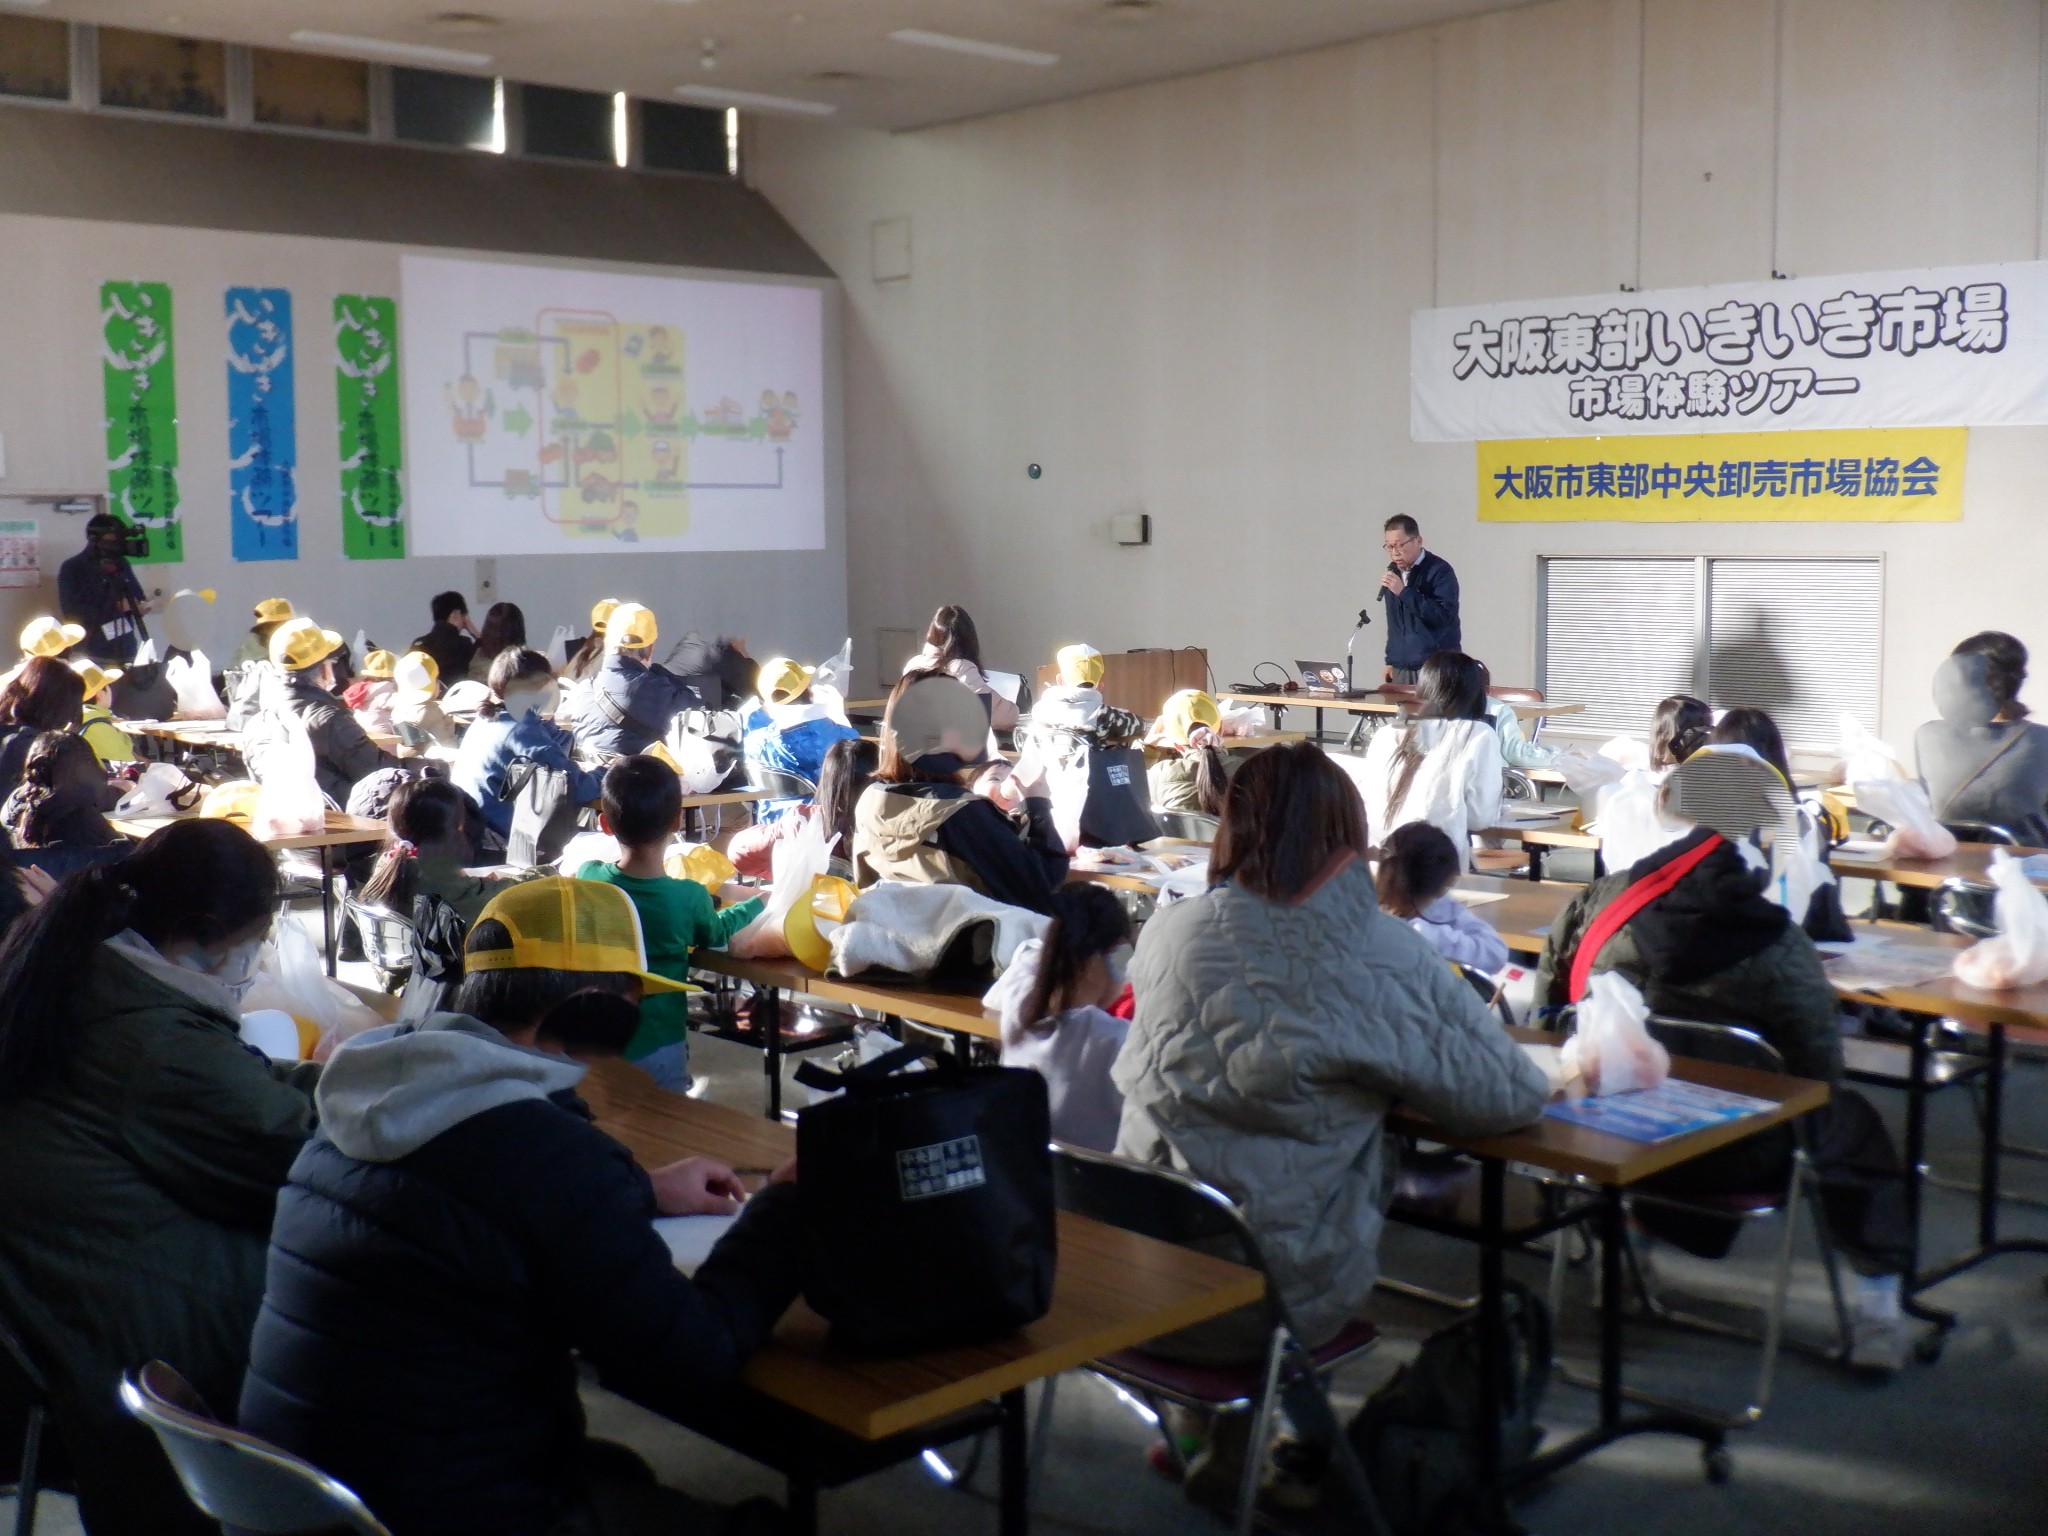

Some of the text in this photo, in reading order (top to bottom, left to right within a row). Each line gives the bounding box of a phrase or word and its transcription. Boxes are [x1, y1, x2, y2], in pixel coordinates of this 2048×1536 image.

[1453, 283, 2008, 380] 大阪東部いきいき市場
[1569, 367, 1860, 422] 市場体験ツアー
[1493, 456, 1941, 500] 大阪市東部中央卸売市場協会
